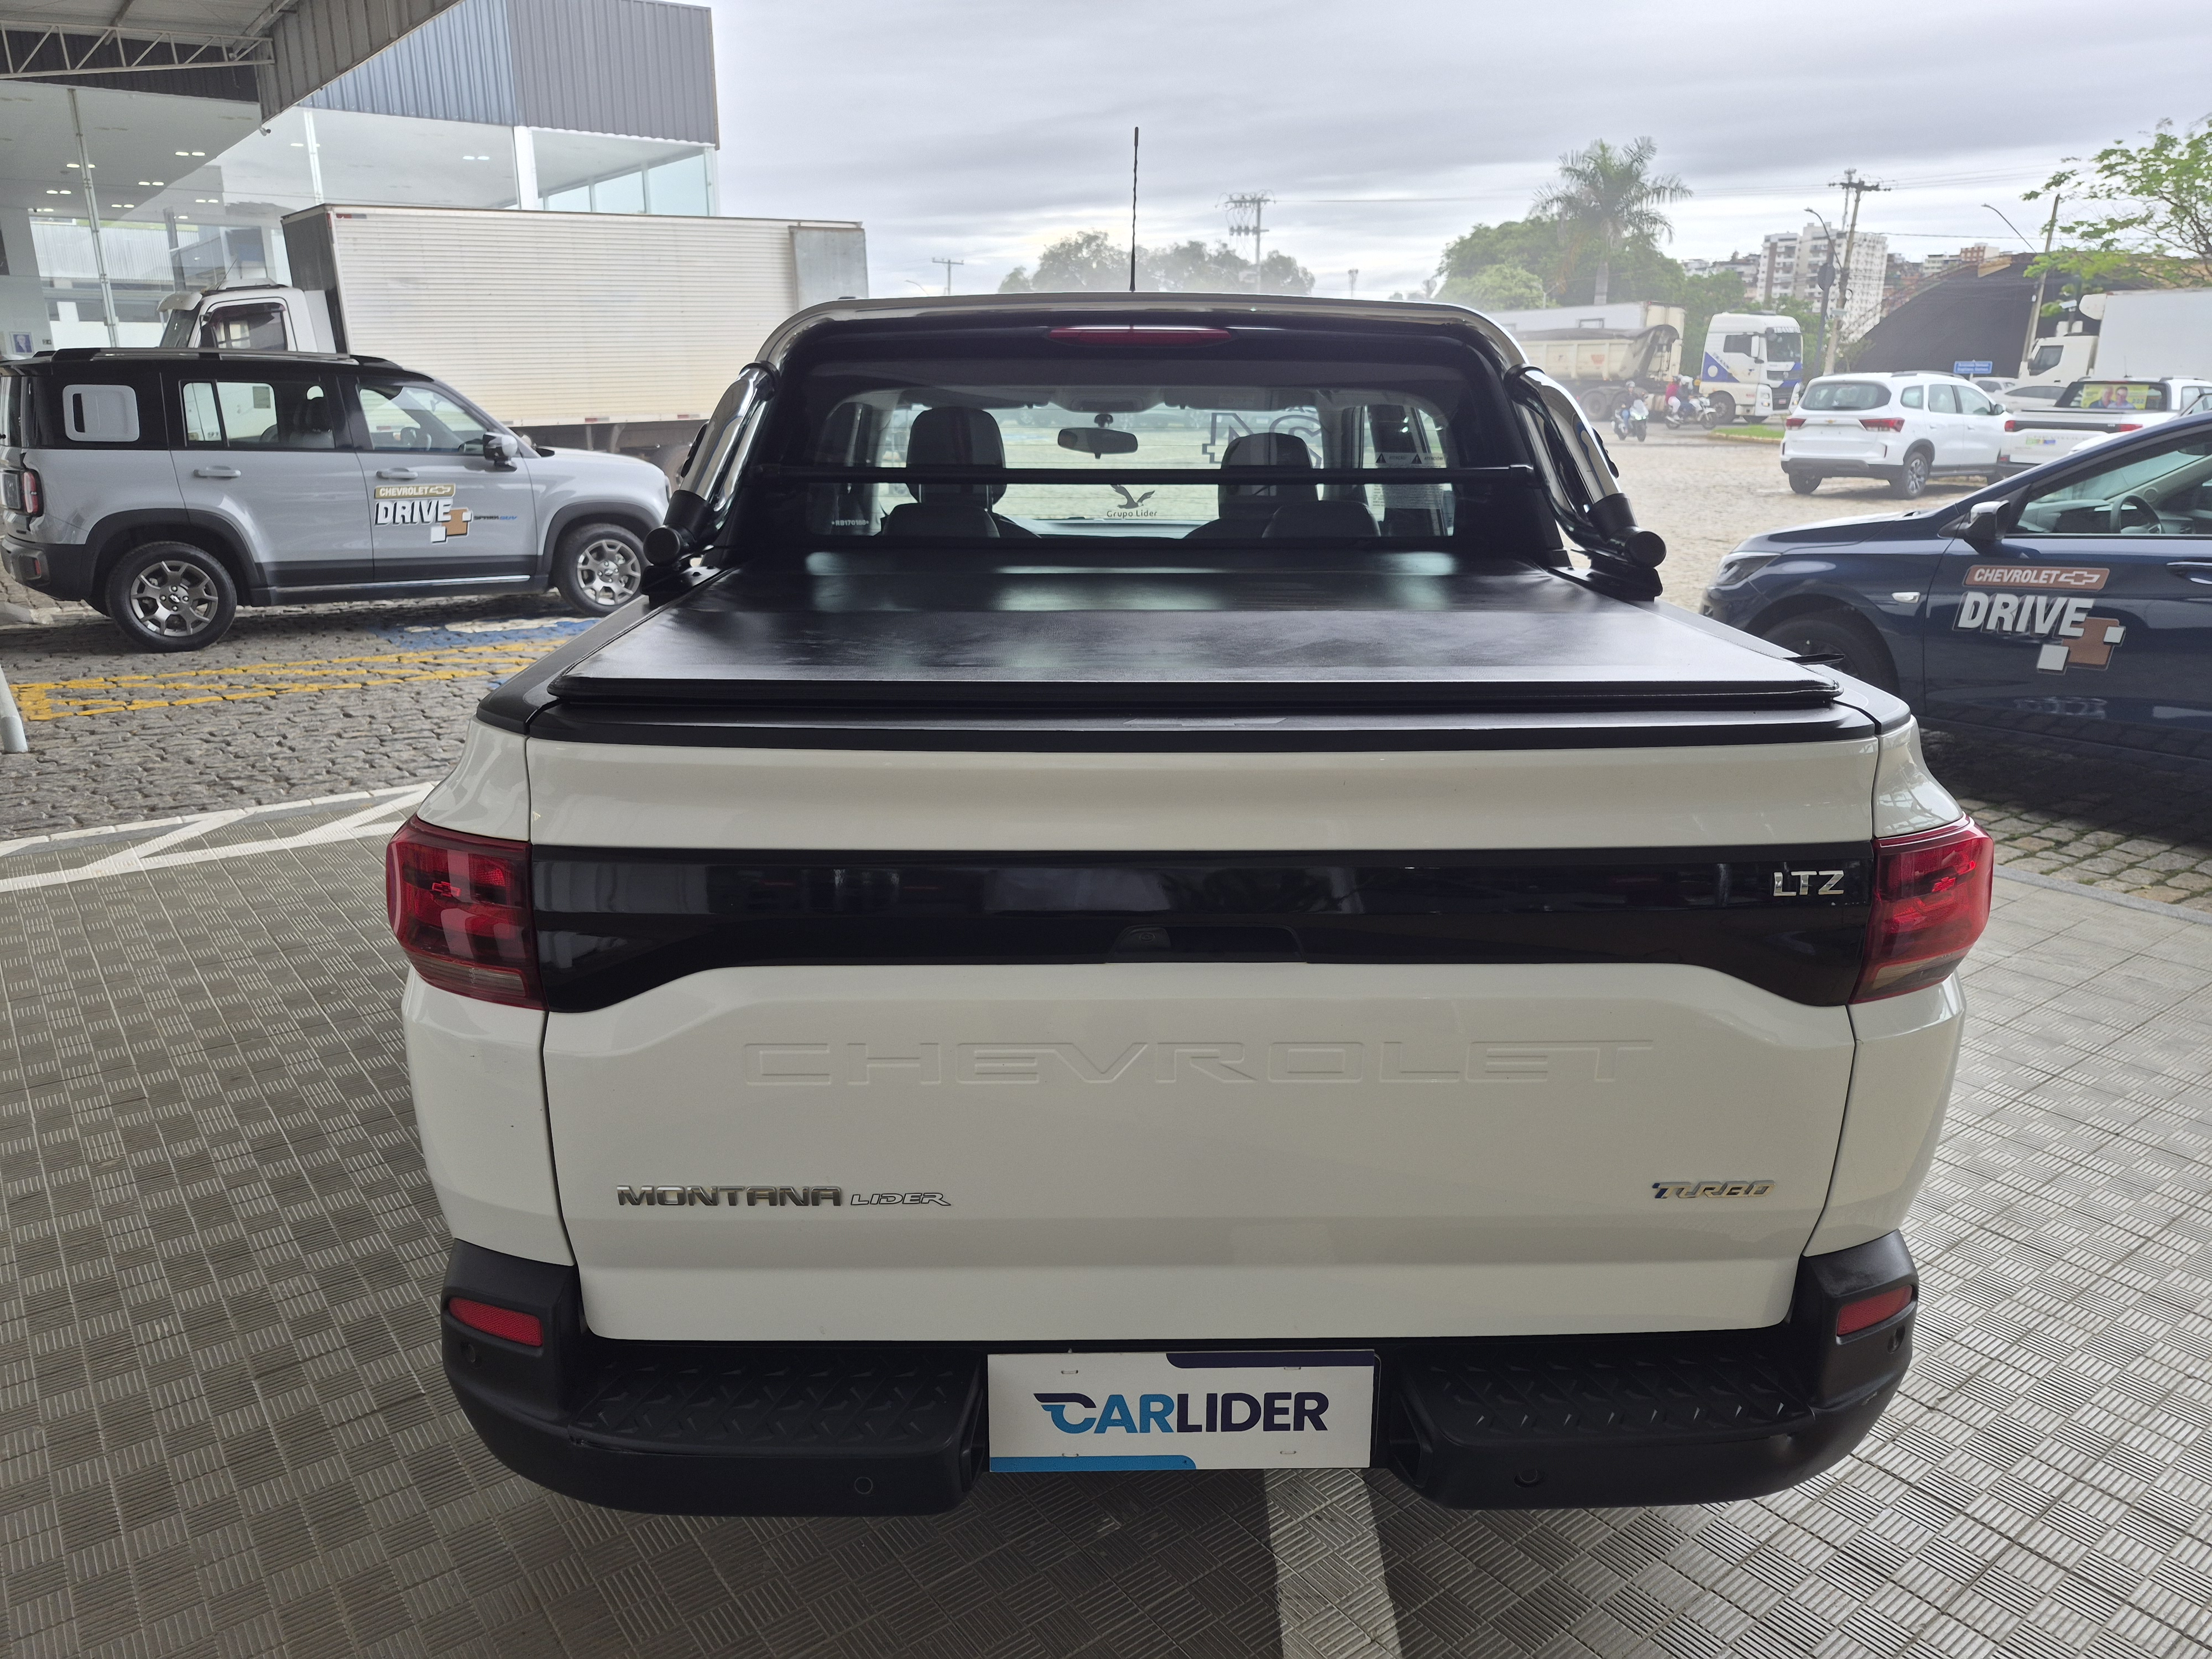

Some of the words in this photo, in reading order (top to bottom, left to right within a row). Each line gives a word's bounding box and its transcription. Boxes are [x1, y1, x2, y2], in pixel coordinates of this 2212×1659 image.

[379, 487, 429, 496] CHEVROLET
[377, 499, 452, 524] DRIVE
[1107, 510, 1133, 519] Grupo
[1974, 568, 2060, 584] CHEVROLET
[1958, 592, 2094, 637] DRIVE
[1773, 870, 1844, 896] LTZ
[744, 1040, 1653, 1085] CHEVROLET
[617, 1185, 842, 1207] MONTANA
[851, 1193, 952, 1206] LIDER
[1652, 1180, 1775, 1199] TURBO
[1033, 1392, 1329, 1434] CARLIDER
